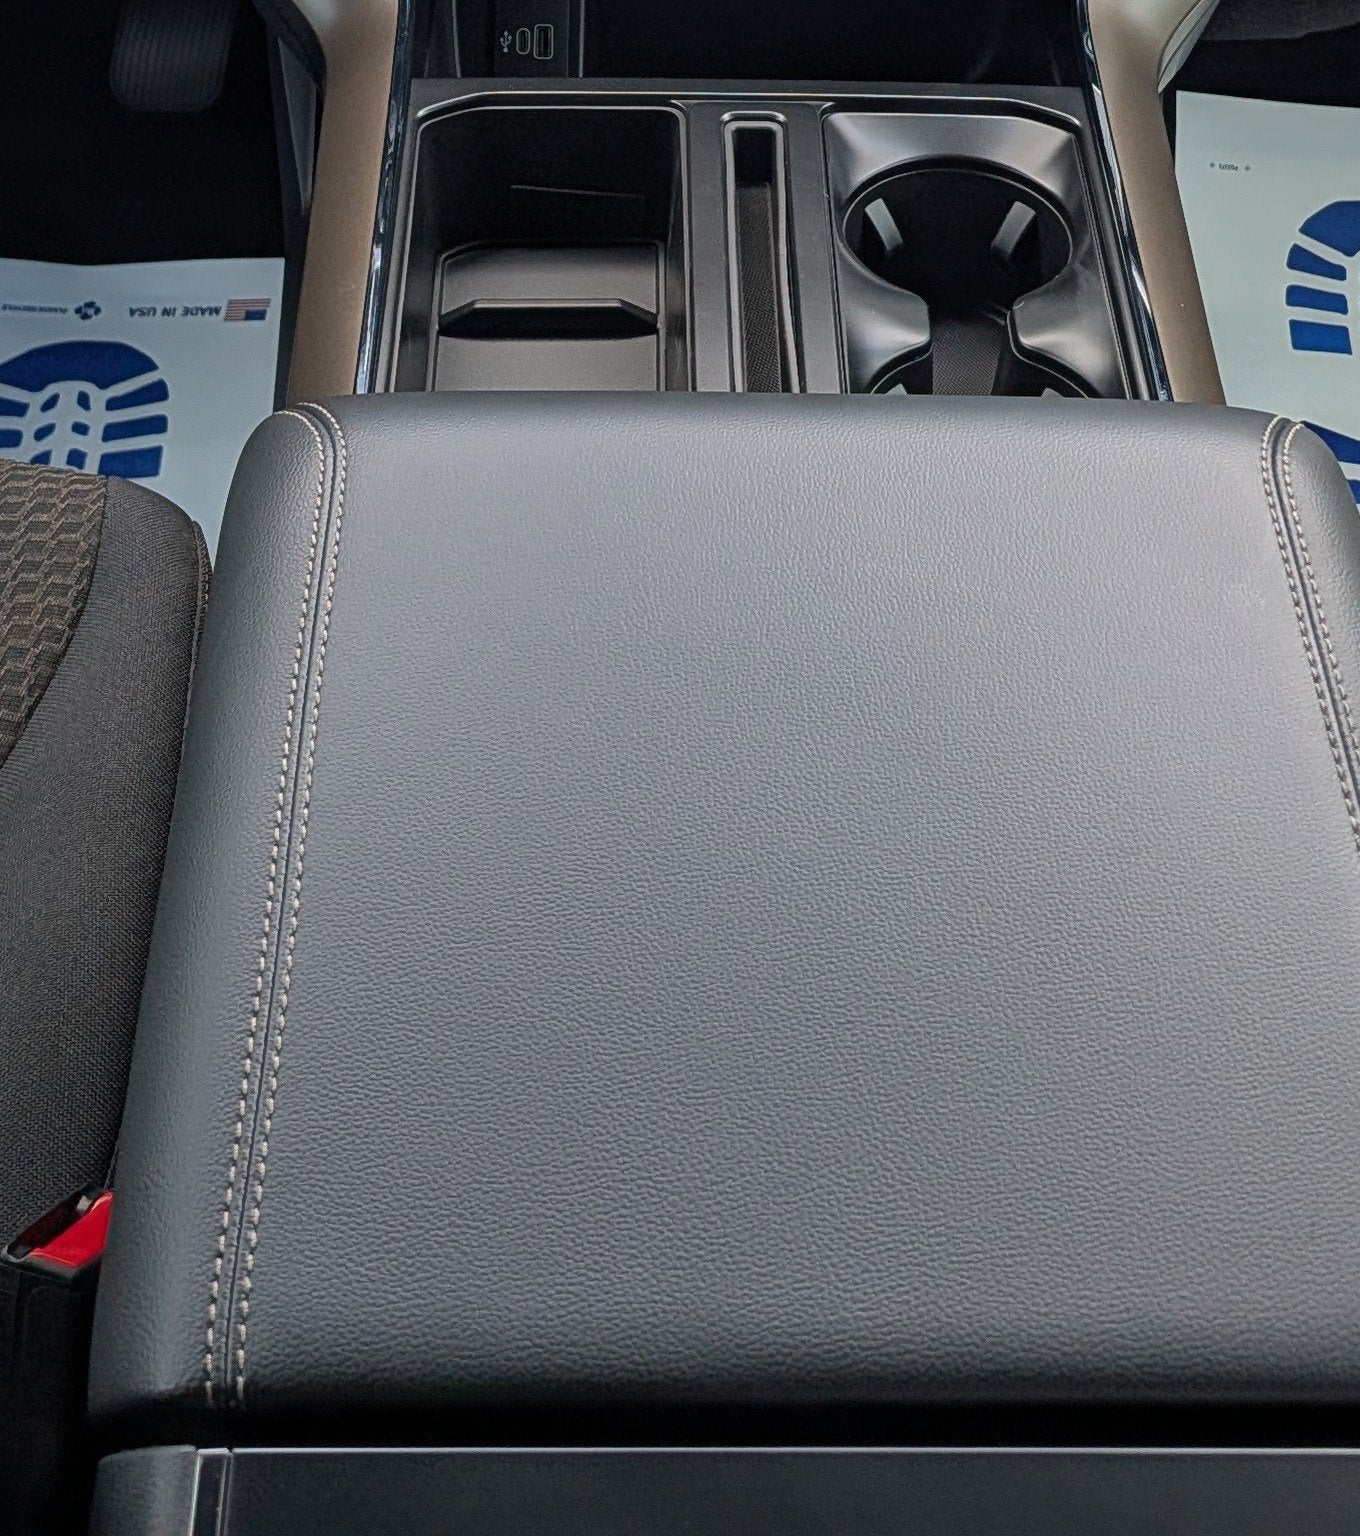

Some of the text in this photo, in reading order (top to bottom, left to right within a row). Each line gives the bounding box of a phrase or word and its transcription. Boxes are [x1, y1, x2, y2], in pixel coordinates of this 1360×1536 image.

[129, 306, 222, 318] MADE IN USA
